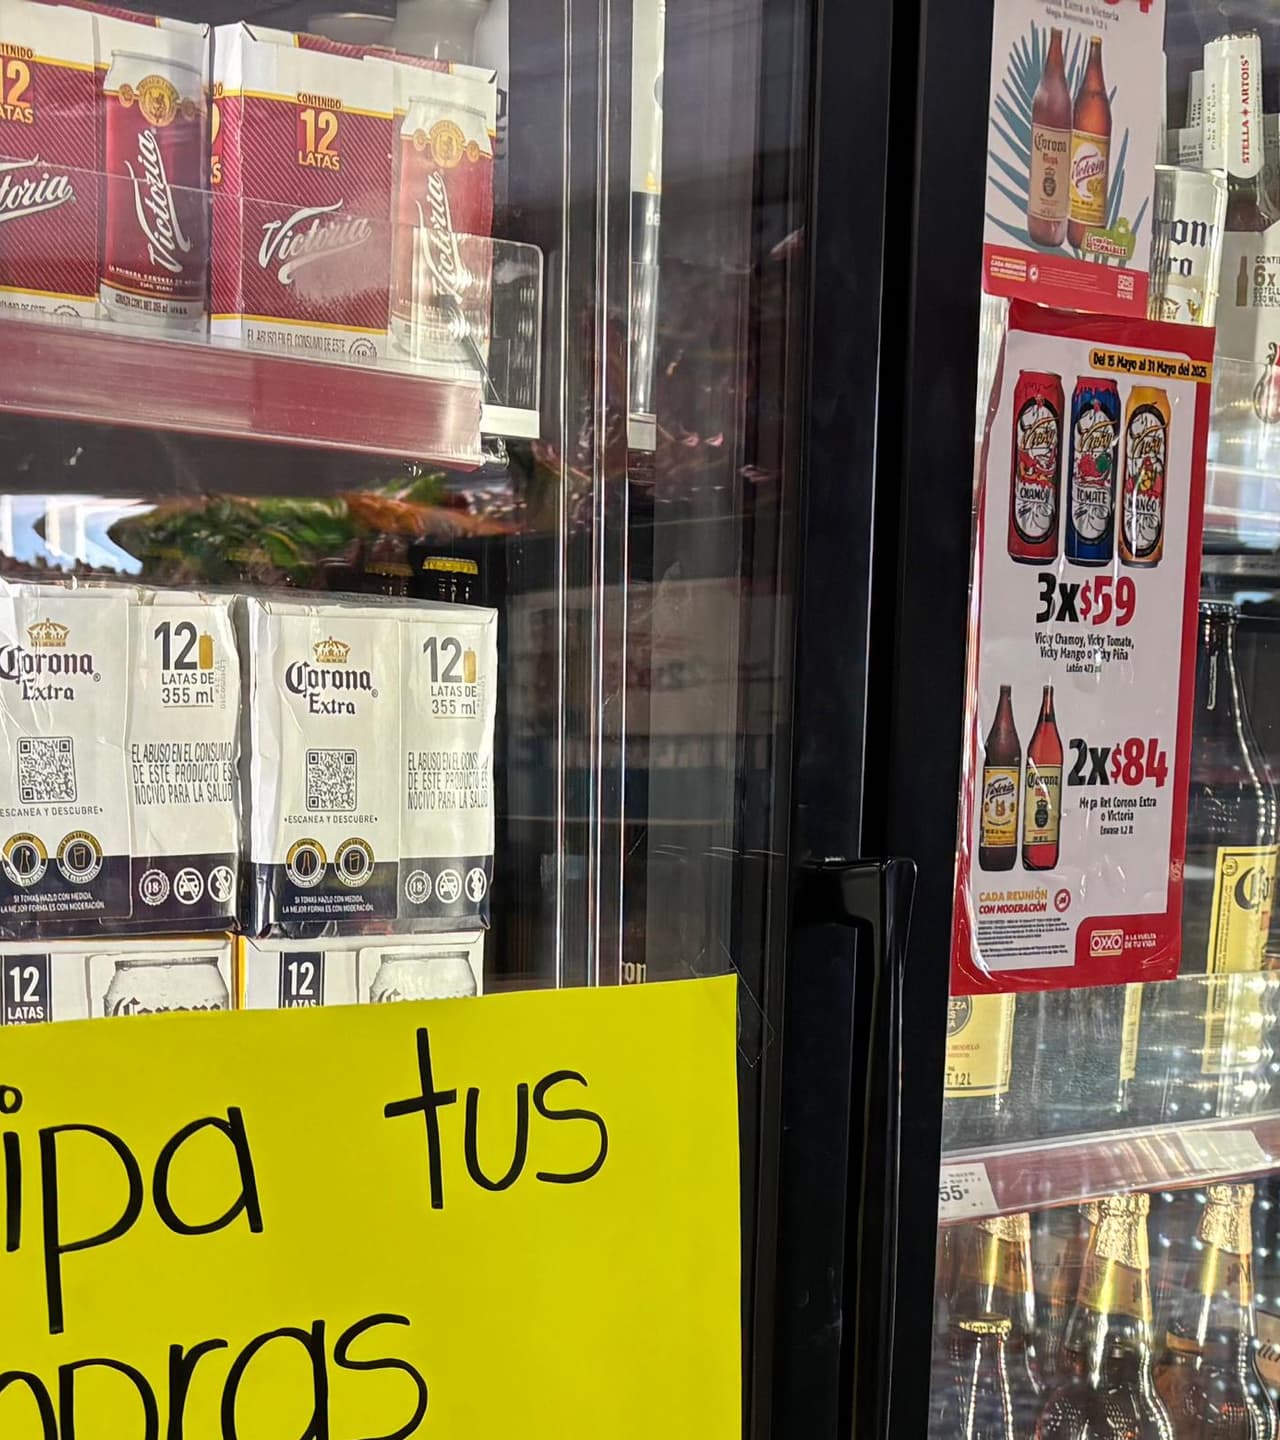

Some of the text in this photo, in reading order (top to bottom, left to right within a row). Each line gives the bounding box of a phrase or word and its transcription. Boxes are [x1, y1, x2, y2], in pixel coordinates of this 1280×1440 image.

[296, 92, 343, 110] CONTENIDO
[1240, 57, 1250, 164] STELLA ARTOIS
[301, 108, 340, 155] 12
[297, 148, 341, 171] LATAS
[125, 128, 191, 273] Victoria
[259, 198, 374, 285] Victoria
[1093, 352, 1190, 377] Del Mayo Mayo del
[1035, 572, 1137, 627] 3x$59
[154, 621, 198, 670] 12
[1055, 634, 1135, 649] Chamoy, Tomate,
[423, 636, 462, 683] 12
[1062, 647, 1085, 662] Mango
[162, 672, 214, 685] LATAS DE
[285, 660, 372, 698] Corona
[22, 680, 74, 700] Extra
[162, 686, 214, 704] 355 ml
[430, 686, 476, 698] LATAS DE
[309, 692, 356, 715] Extra
[432, 699, 476, 715] 355 ml
[132, 742, 233, 763] EL ABUSO EN EL CONSUMO
[1068, 737, 1168, 788] 2x$84
[133, 763, 233, 784] DE ESTE PRODUCTO ES
[135, 783, 233, 805] NOCIVO PARA LA SALUD
[1113, 796, 1157, 809] Corona Extra
[1107, 810, 1134, 822] Victoria
[979, 887, 1048, 902] CADA REUNIÓN
[979, 901, 1047, 915] CON MODERACIÓN
[9, 966, 40, 1002] 12
[286, 960, 315, 997] 12
[8, 1006, 44, 1020] LATAS
[382, 1026, 611, 1212] tus
